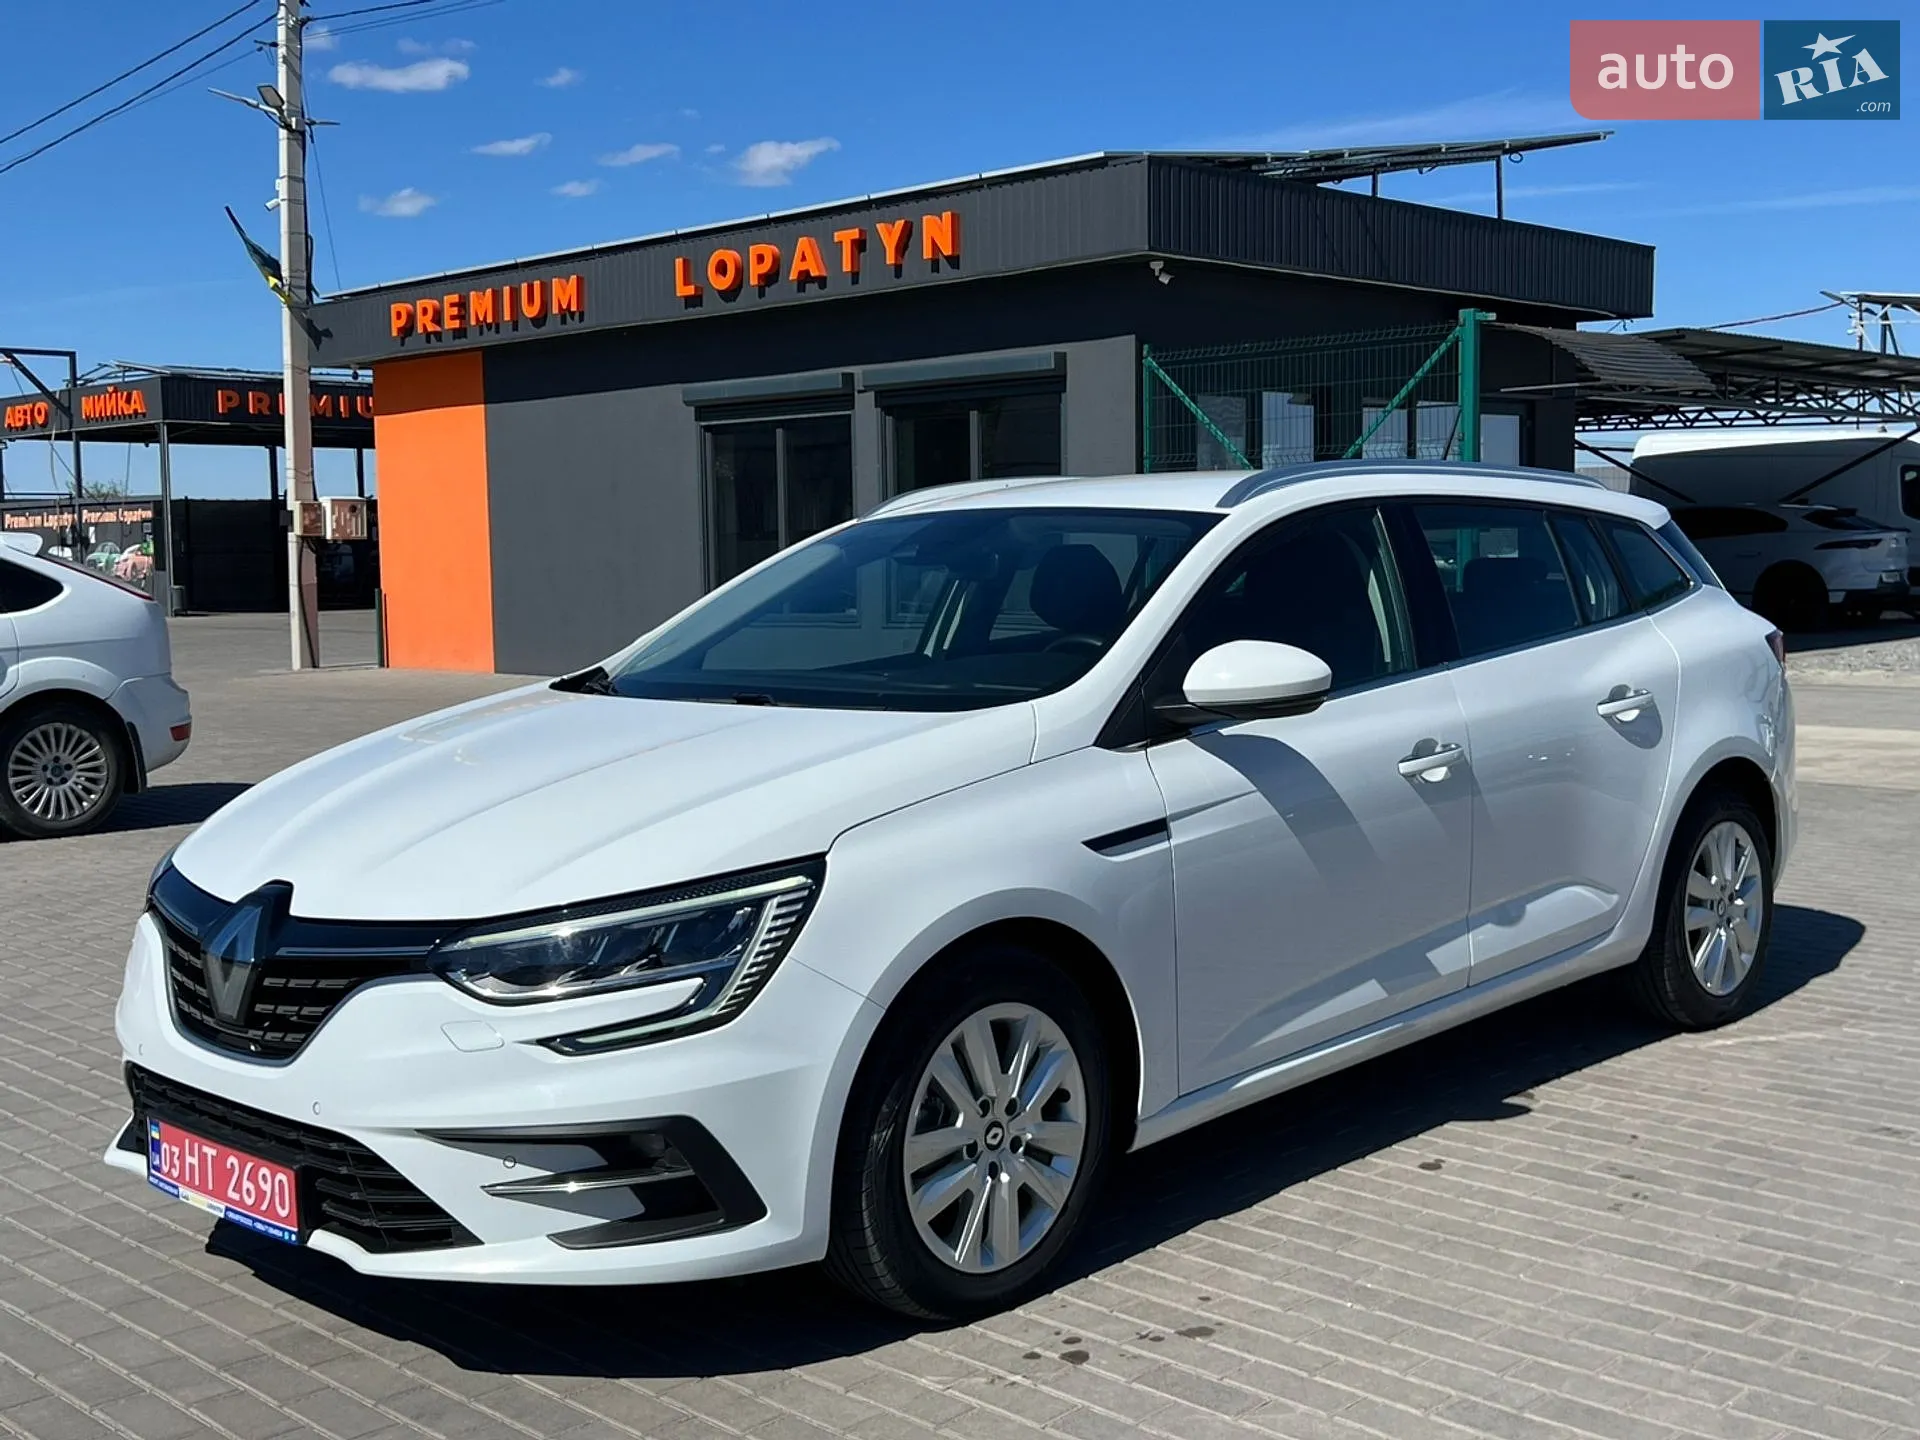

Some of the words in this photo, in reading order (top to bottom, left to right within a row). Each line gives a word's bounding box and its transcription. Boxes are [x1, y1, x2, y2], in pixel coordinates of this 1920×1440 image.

[390, 275, 582, 338] PREMIUM
[674, 211, 960, 298] LOPATYN
[4, 402, 49, 429] АВТО
[81, 386, 147, 420] МИЙКА
[226, 1154, 290, 1218] 2690
